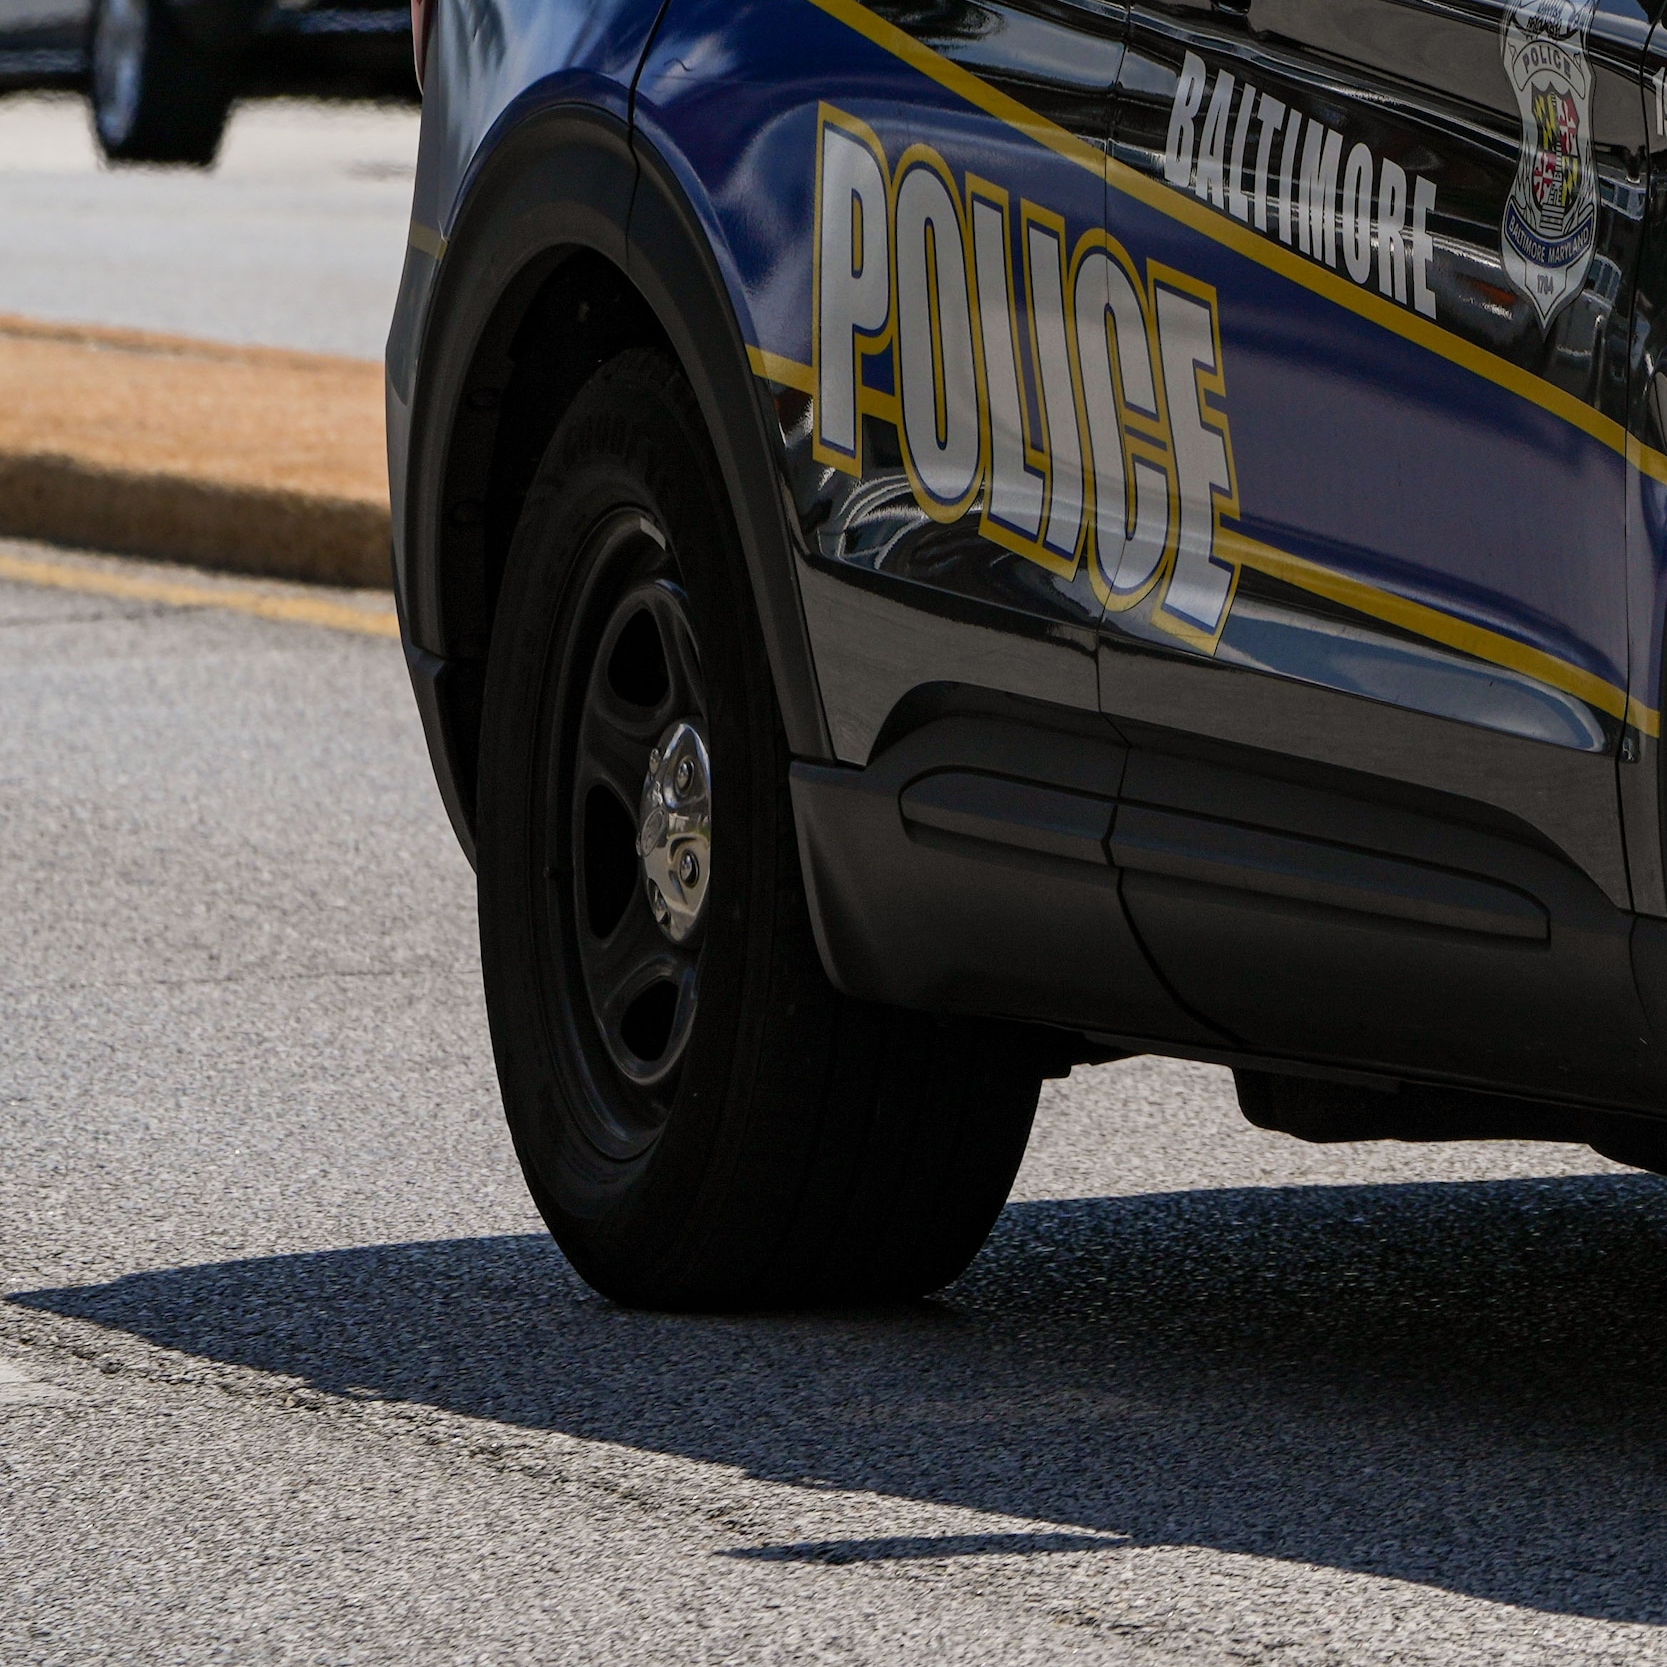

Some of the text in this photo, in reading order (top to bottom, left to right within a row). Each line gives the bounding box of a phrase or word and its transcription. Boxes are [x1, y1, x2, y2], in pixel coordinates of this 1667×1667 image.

[1522, 44, 1572, 80] POLICE
[1162, 50, 1439, 320] BALTIMORE
[1508, 215, 1590, 264] BALTIMORE MARYLAND
[811, 99, 1242, 657] POLICE
